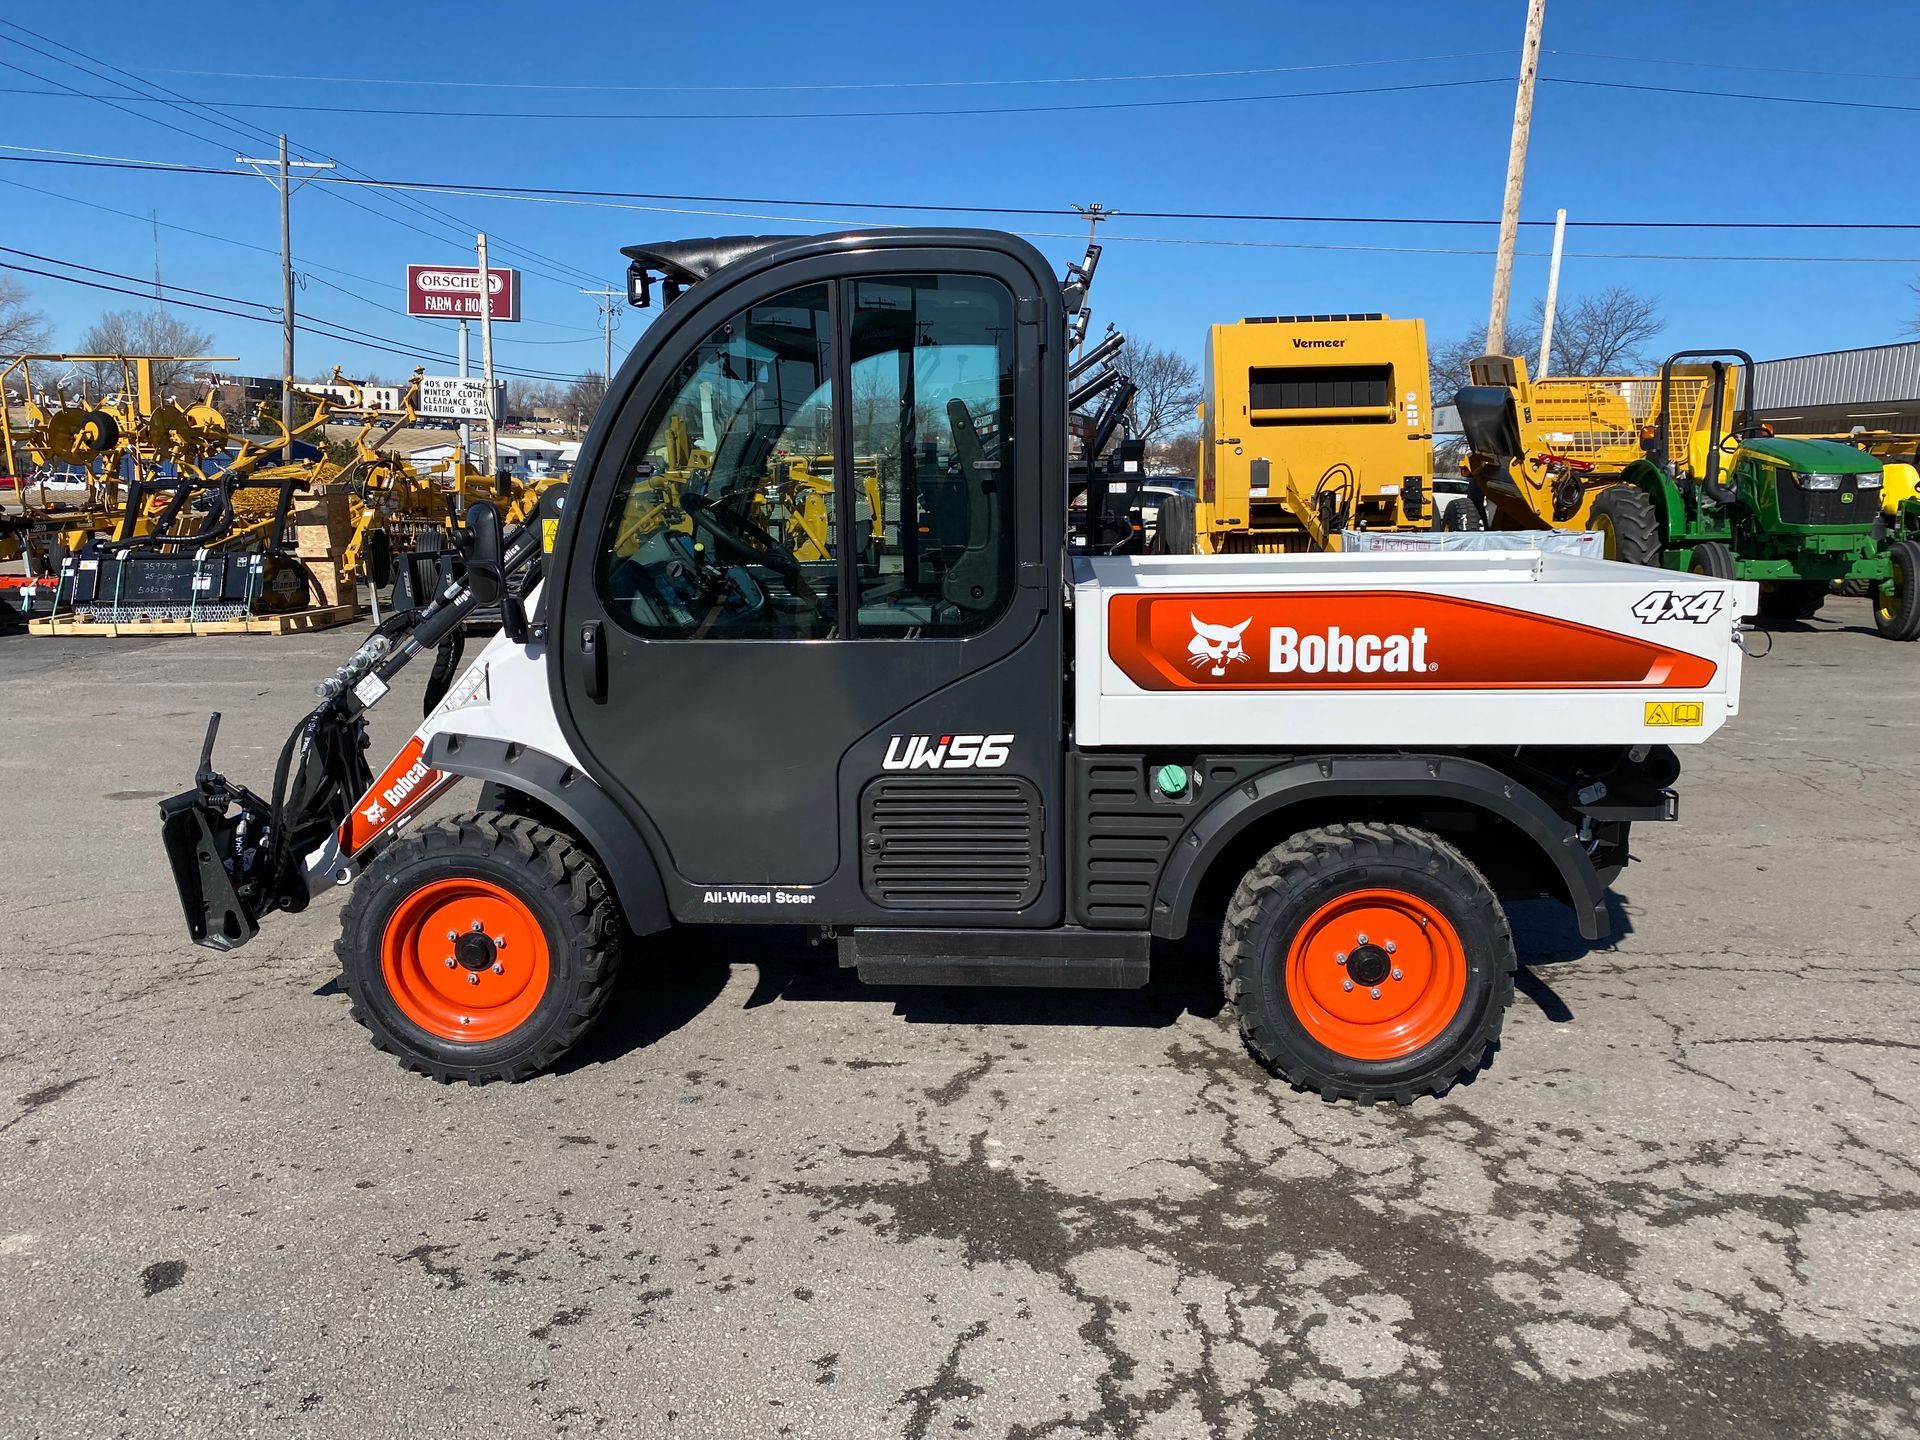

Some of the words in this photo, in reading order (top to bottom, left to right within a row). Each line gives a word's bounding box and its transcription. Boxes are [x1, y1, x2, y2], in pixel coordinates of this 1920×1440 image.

[422, 275, 497, 289] ORSCHEN
[424, 295, 452, 311] FARM
[454, 298, 462, 312] &
[464, 297, 494, 314] HOE
[1292, 338, 1346, 349] Vermeer
[424, 380, 440, 389] 40%
[443, 381, 458, 389] OFF
[424, 388, 451, 397] WINTER
[423, 396, 467, 406] CLEARANCE
[473, 399, 487, 407] SAL
[423, 404, 455, 414] HEATING
[460, 407, 471, 415] ON
[453, 589, 472, 607] High
[1631, 591, 1724, 624] 4x4
[1269, 626, 1428, 674] Bobcat
[382, 756, 431, 808] Bobcat
[703, 891, 771, 904] All-Wheel
[775, 891, 816, 904] Steer
